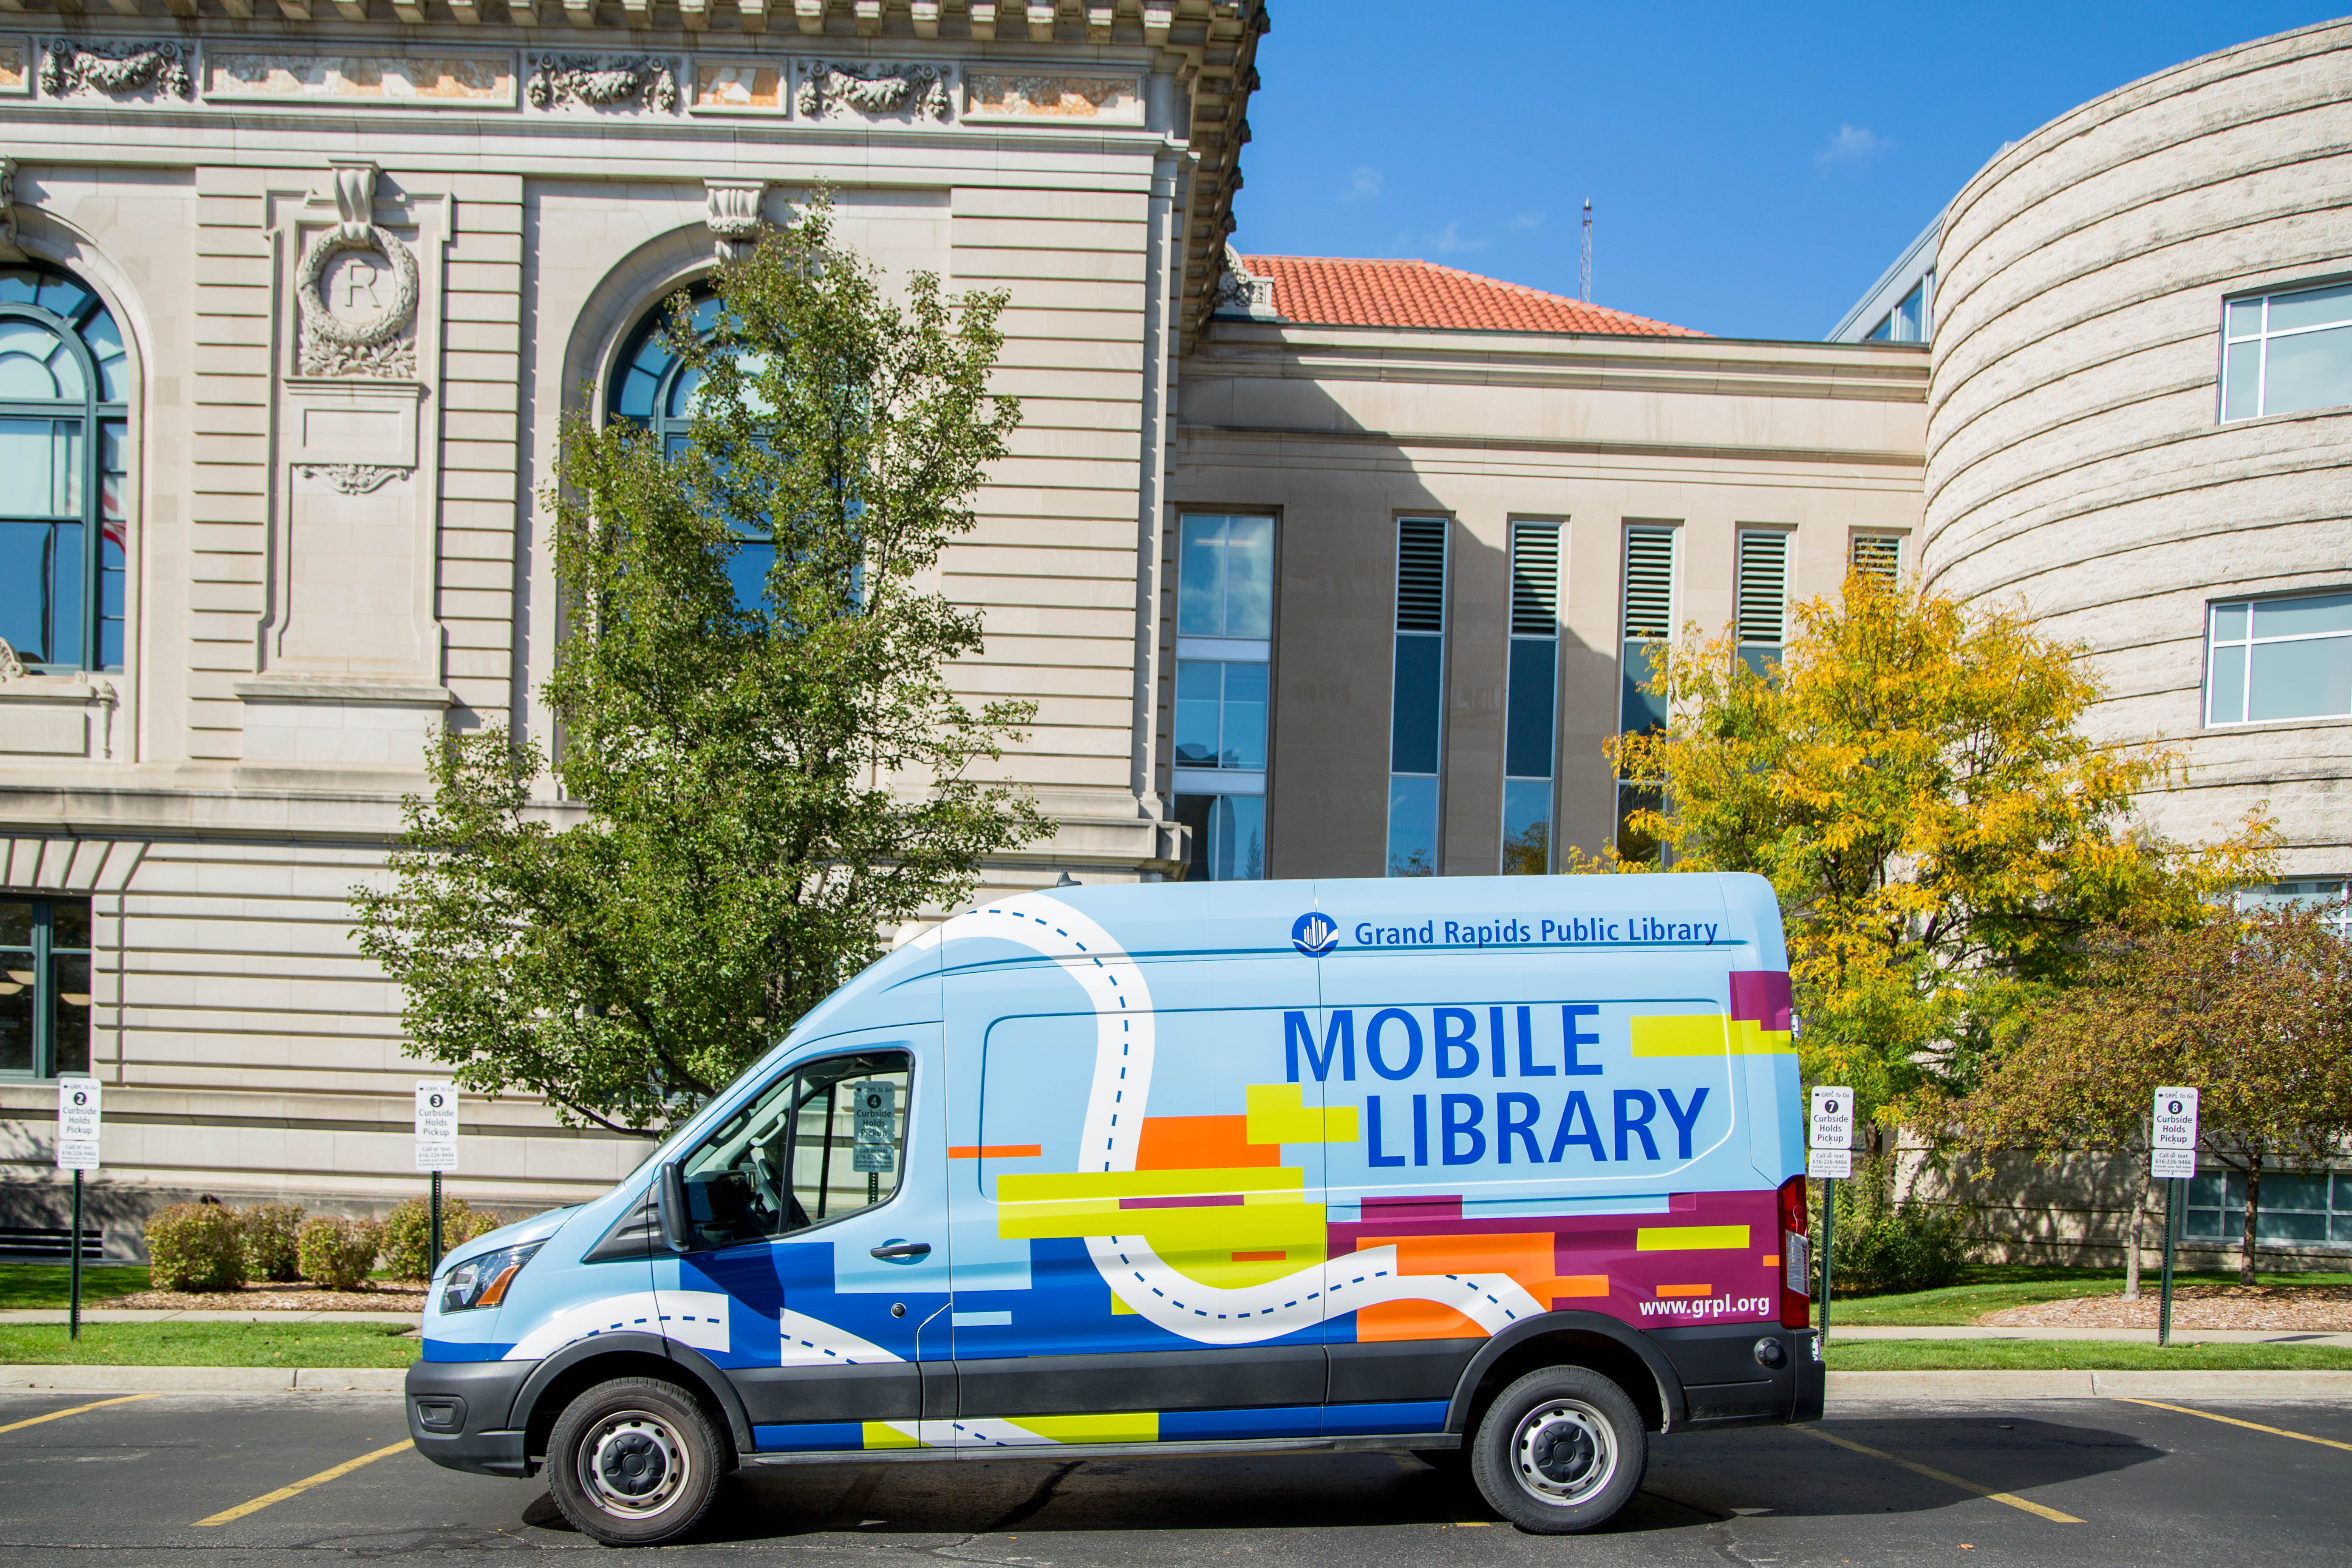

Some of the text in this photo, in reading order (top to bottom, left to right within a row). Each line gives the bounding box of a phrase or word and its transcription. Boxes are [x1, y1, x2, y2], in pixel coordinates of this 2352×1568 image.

[345, 264, 382, 308] R
[1356, 917, 1718, 948] Grand Rapids Public Library
[1284, 1005, 1603, 1083] MOBILE
[76, 1093, 84, 1104] 2
[433, 1095, 440, 1107] 3
[871, 1097, 877, 1106] 4
[1829, 1101, 1836, 1112] 7
[2172, 1103, 2179, 1112] 8
[419, 1109, 454, 1117] Curbside
[857, 1109, 892, 1118] Curbside
[863, 1119, 886, 1127] Holds
[2157, 1115, 2193, 1124] Curbside
[66, 1126, 92, 1135] Pickup
[1366, 1087, 1710, 1168] LIBRARY
[423, 1128, 449, 1137] Pickup
[861, 1129, 887, 1138] Pickup
[1817, 1134, 1843, 1143] Pickup
[2160, 1135, 2187, 1144] Pickup
[1639, 1293, 1770, 1318] www.grpl.org
